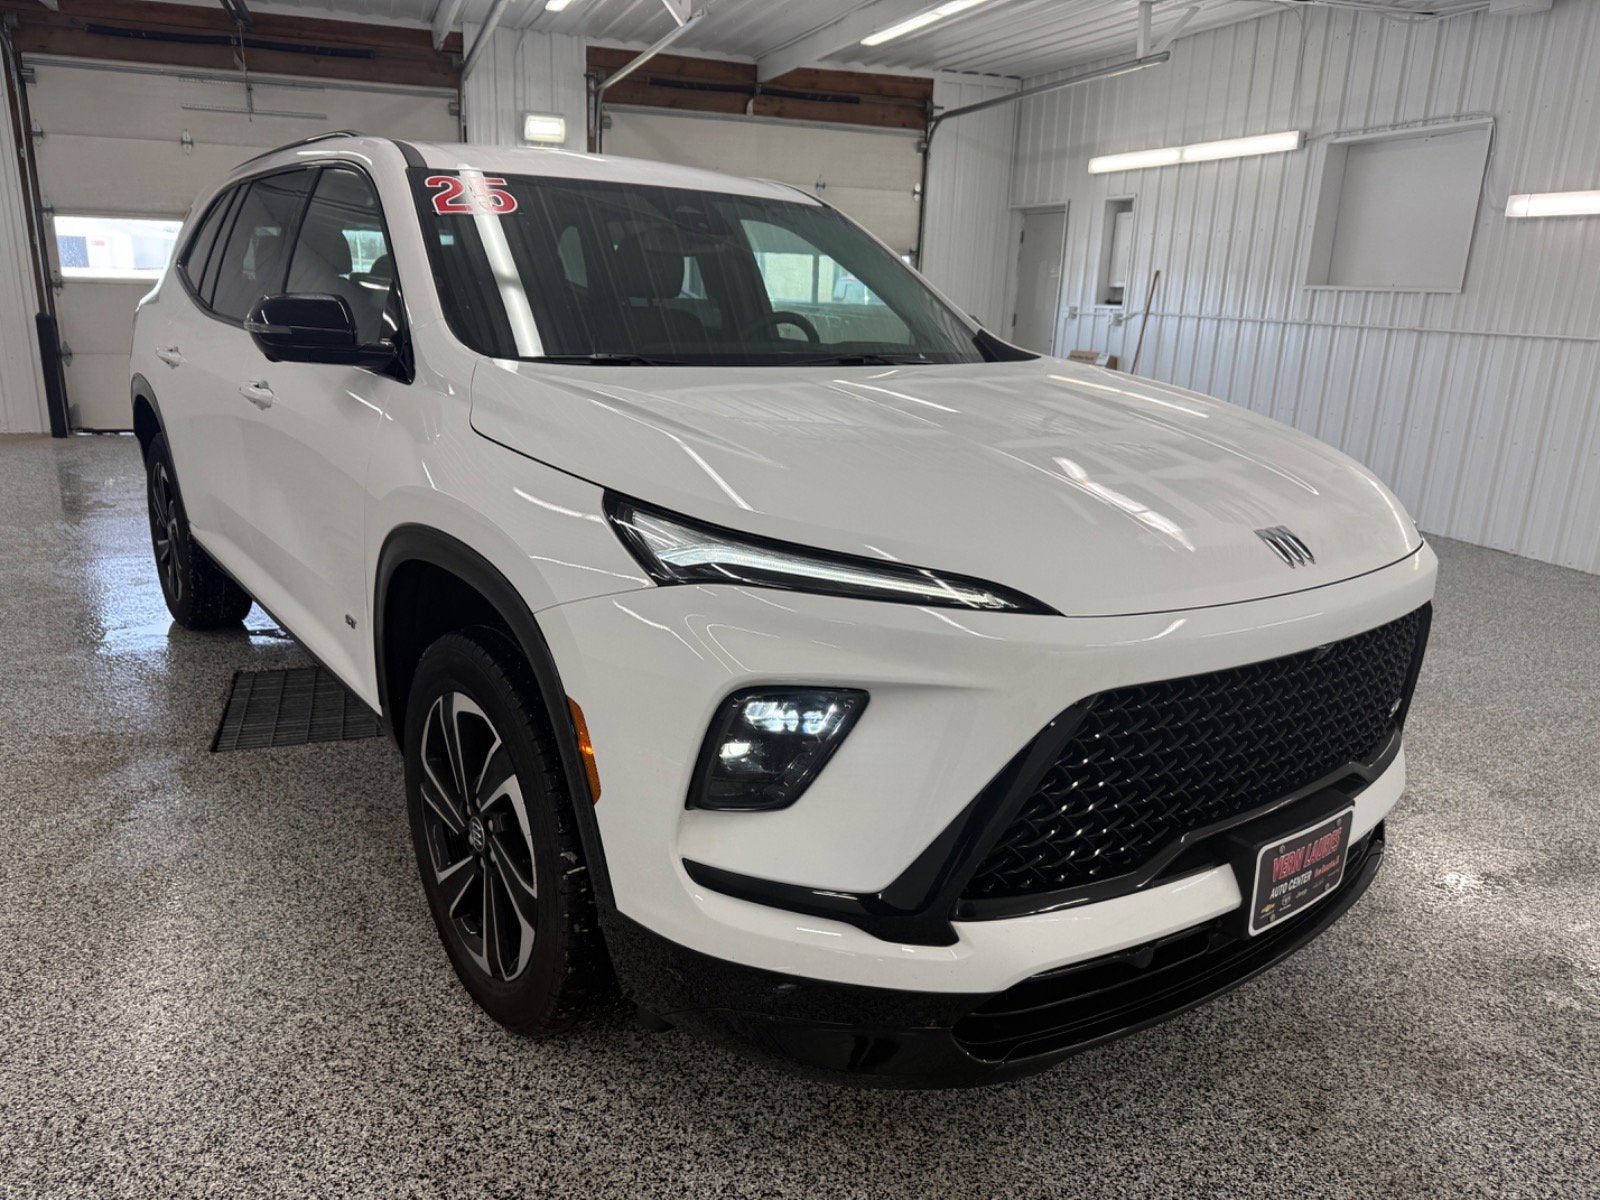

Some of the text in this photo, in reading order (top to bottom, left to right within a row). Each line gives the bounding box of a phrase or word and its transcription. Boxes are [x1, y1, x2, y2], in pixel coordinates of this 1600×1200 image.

[424, 175, 518, 215] 25
[1272, 846, 1305, 883] VERN
[1269, 881, 1288, 900] AUTO
[1288, 870, 1313, 891] CENTER
